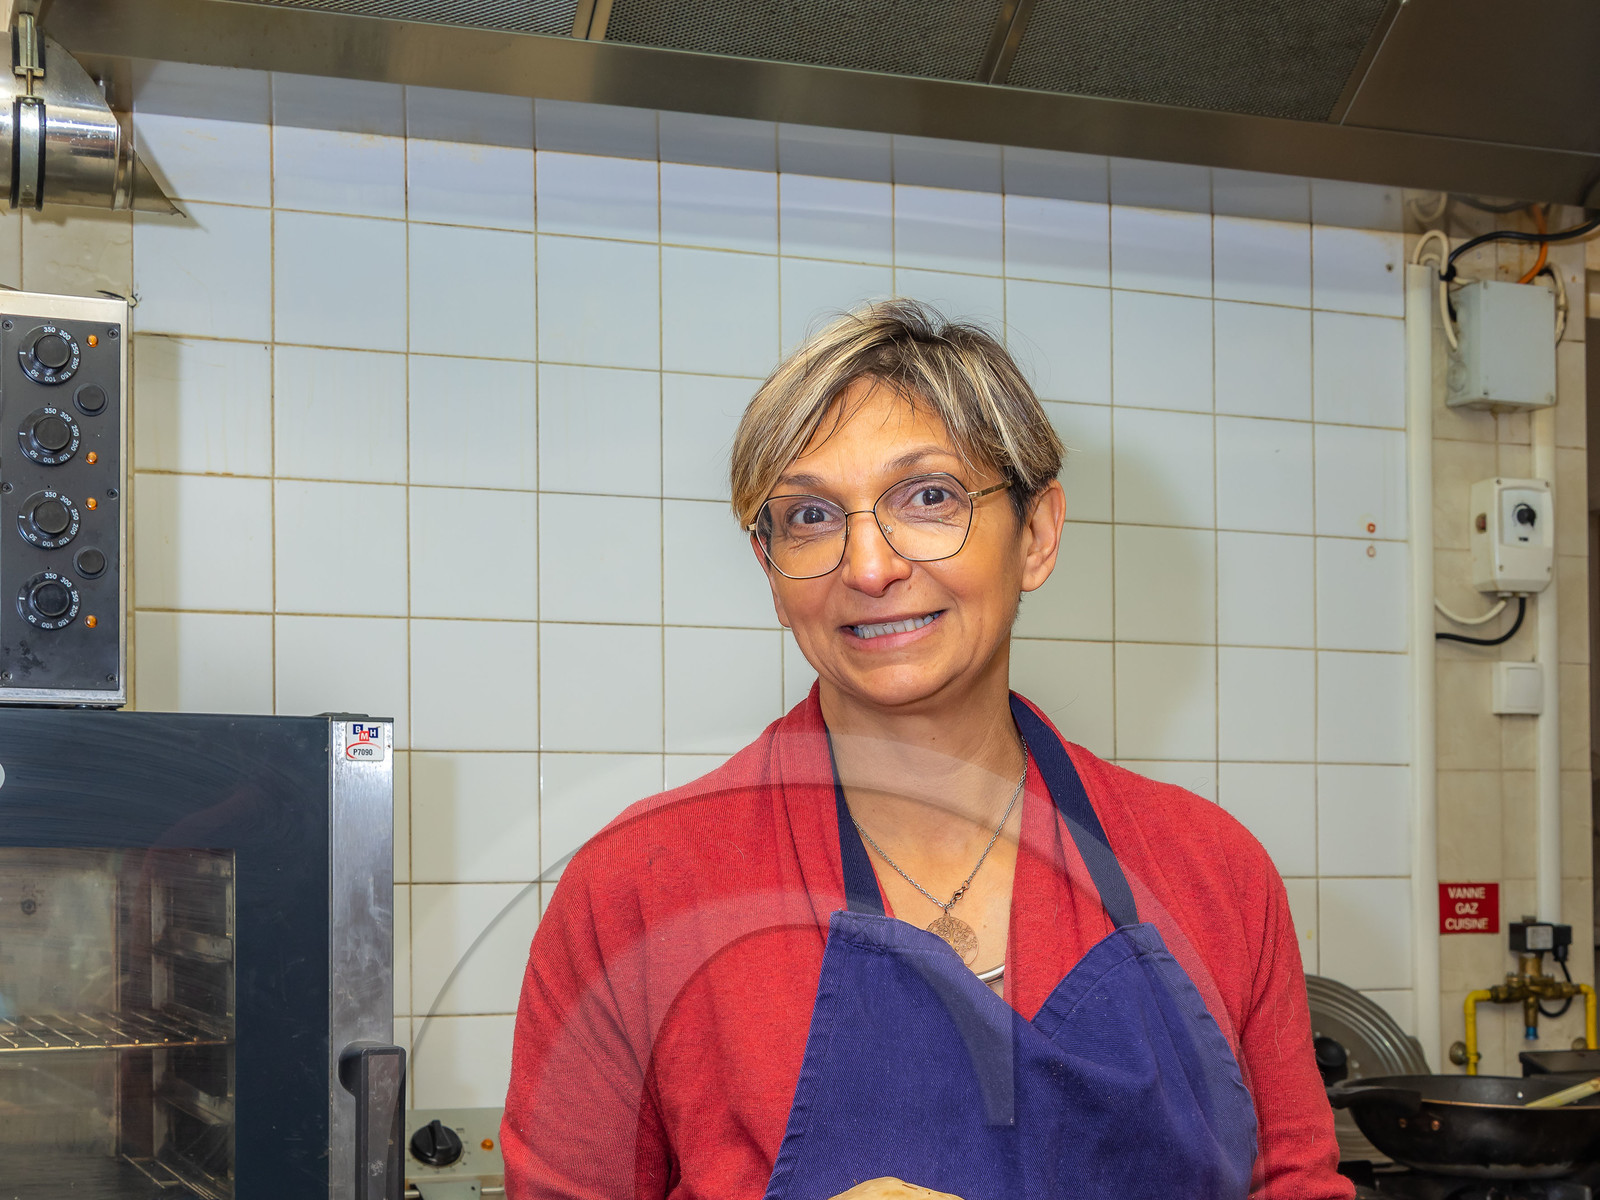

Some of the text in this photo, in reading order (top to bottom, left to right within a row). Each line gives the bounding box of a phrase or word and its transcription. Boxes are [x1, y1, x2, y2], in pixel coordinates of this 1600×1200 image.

[59, 330, 71, 340] 300
[70, 343, 79, 354] 250
[72, 358, 80, 370] 200
[60, 371, 72, 380] 150
[60, 412, 72, 422] 300
[72, 425, 80, 436] 250
[71, 440, 79, 452] 200
[30, 450, 38, 458] 50
[60, 453, 70, 462] 150
[60, 496, 72, 506] 300
[71, 509, 79, 520] 250
[70, 524, 78, 536] 200
[29, 534, 38, 542] 50
[58, 537, 70, 545] 150
[60, 577, 72, 588] 300
[70, 605, 78, 617] 200
[28, 614, 37, 623] 50
[58, 618, 68, 627] 150
[1448, 886, 1486, 899] VANNE
[1455, 902, 1478, 914] GAZ
[1445, 918, 1488, 930] CUISINE
